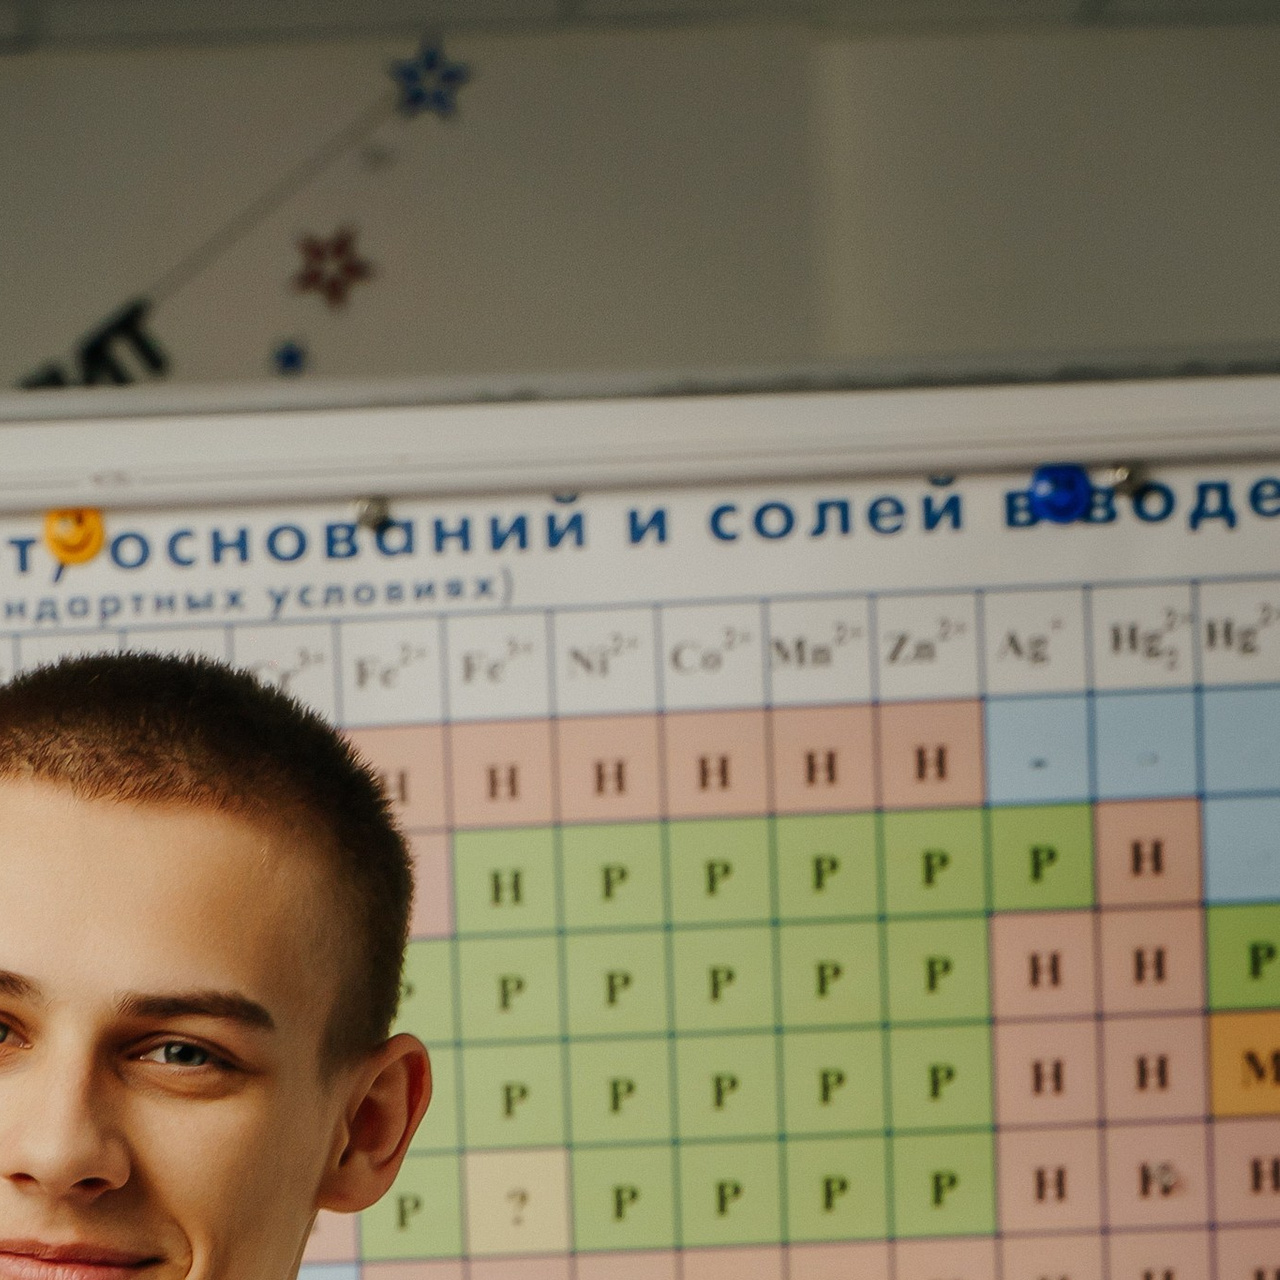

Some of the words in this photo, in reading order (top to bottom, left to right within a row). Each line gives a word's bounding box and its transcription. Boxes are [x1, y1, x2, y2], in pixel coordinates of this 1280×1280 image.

[110, 494, 586, 570] оснований
[628, 507, 668, 544] и
[709, 474, 963, 541] солей
[268, 568, 514, 620] условиях)
[487, 765, 519, 800] Н
[594, 759, 626, 795] Н
[698, 755, 730, 791] Н
[804, 749, 838, 786] Н
[914, 744, 948, 782] Н
[490, 869, 523, 906] Н
[602, 865, 628, 901] Р
[705, 860, 732, 896] Р
[812, 855, 840, 892] Р
[922, 850, 950, 888] Р
[1029, 845, 1058, 884] Р
[1130, 838, 1165, 878] Н
[397, 1196, 422, 1229] Р
[613, 1185, 640, 1221] Р
[715, 1180, 743, 1217] Р
[822, 1175, 849, 1213] Р
[931, 1170, 959, 1208] Р
[1034, 1165, 1067, 1203] Н
